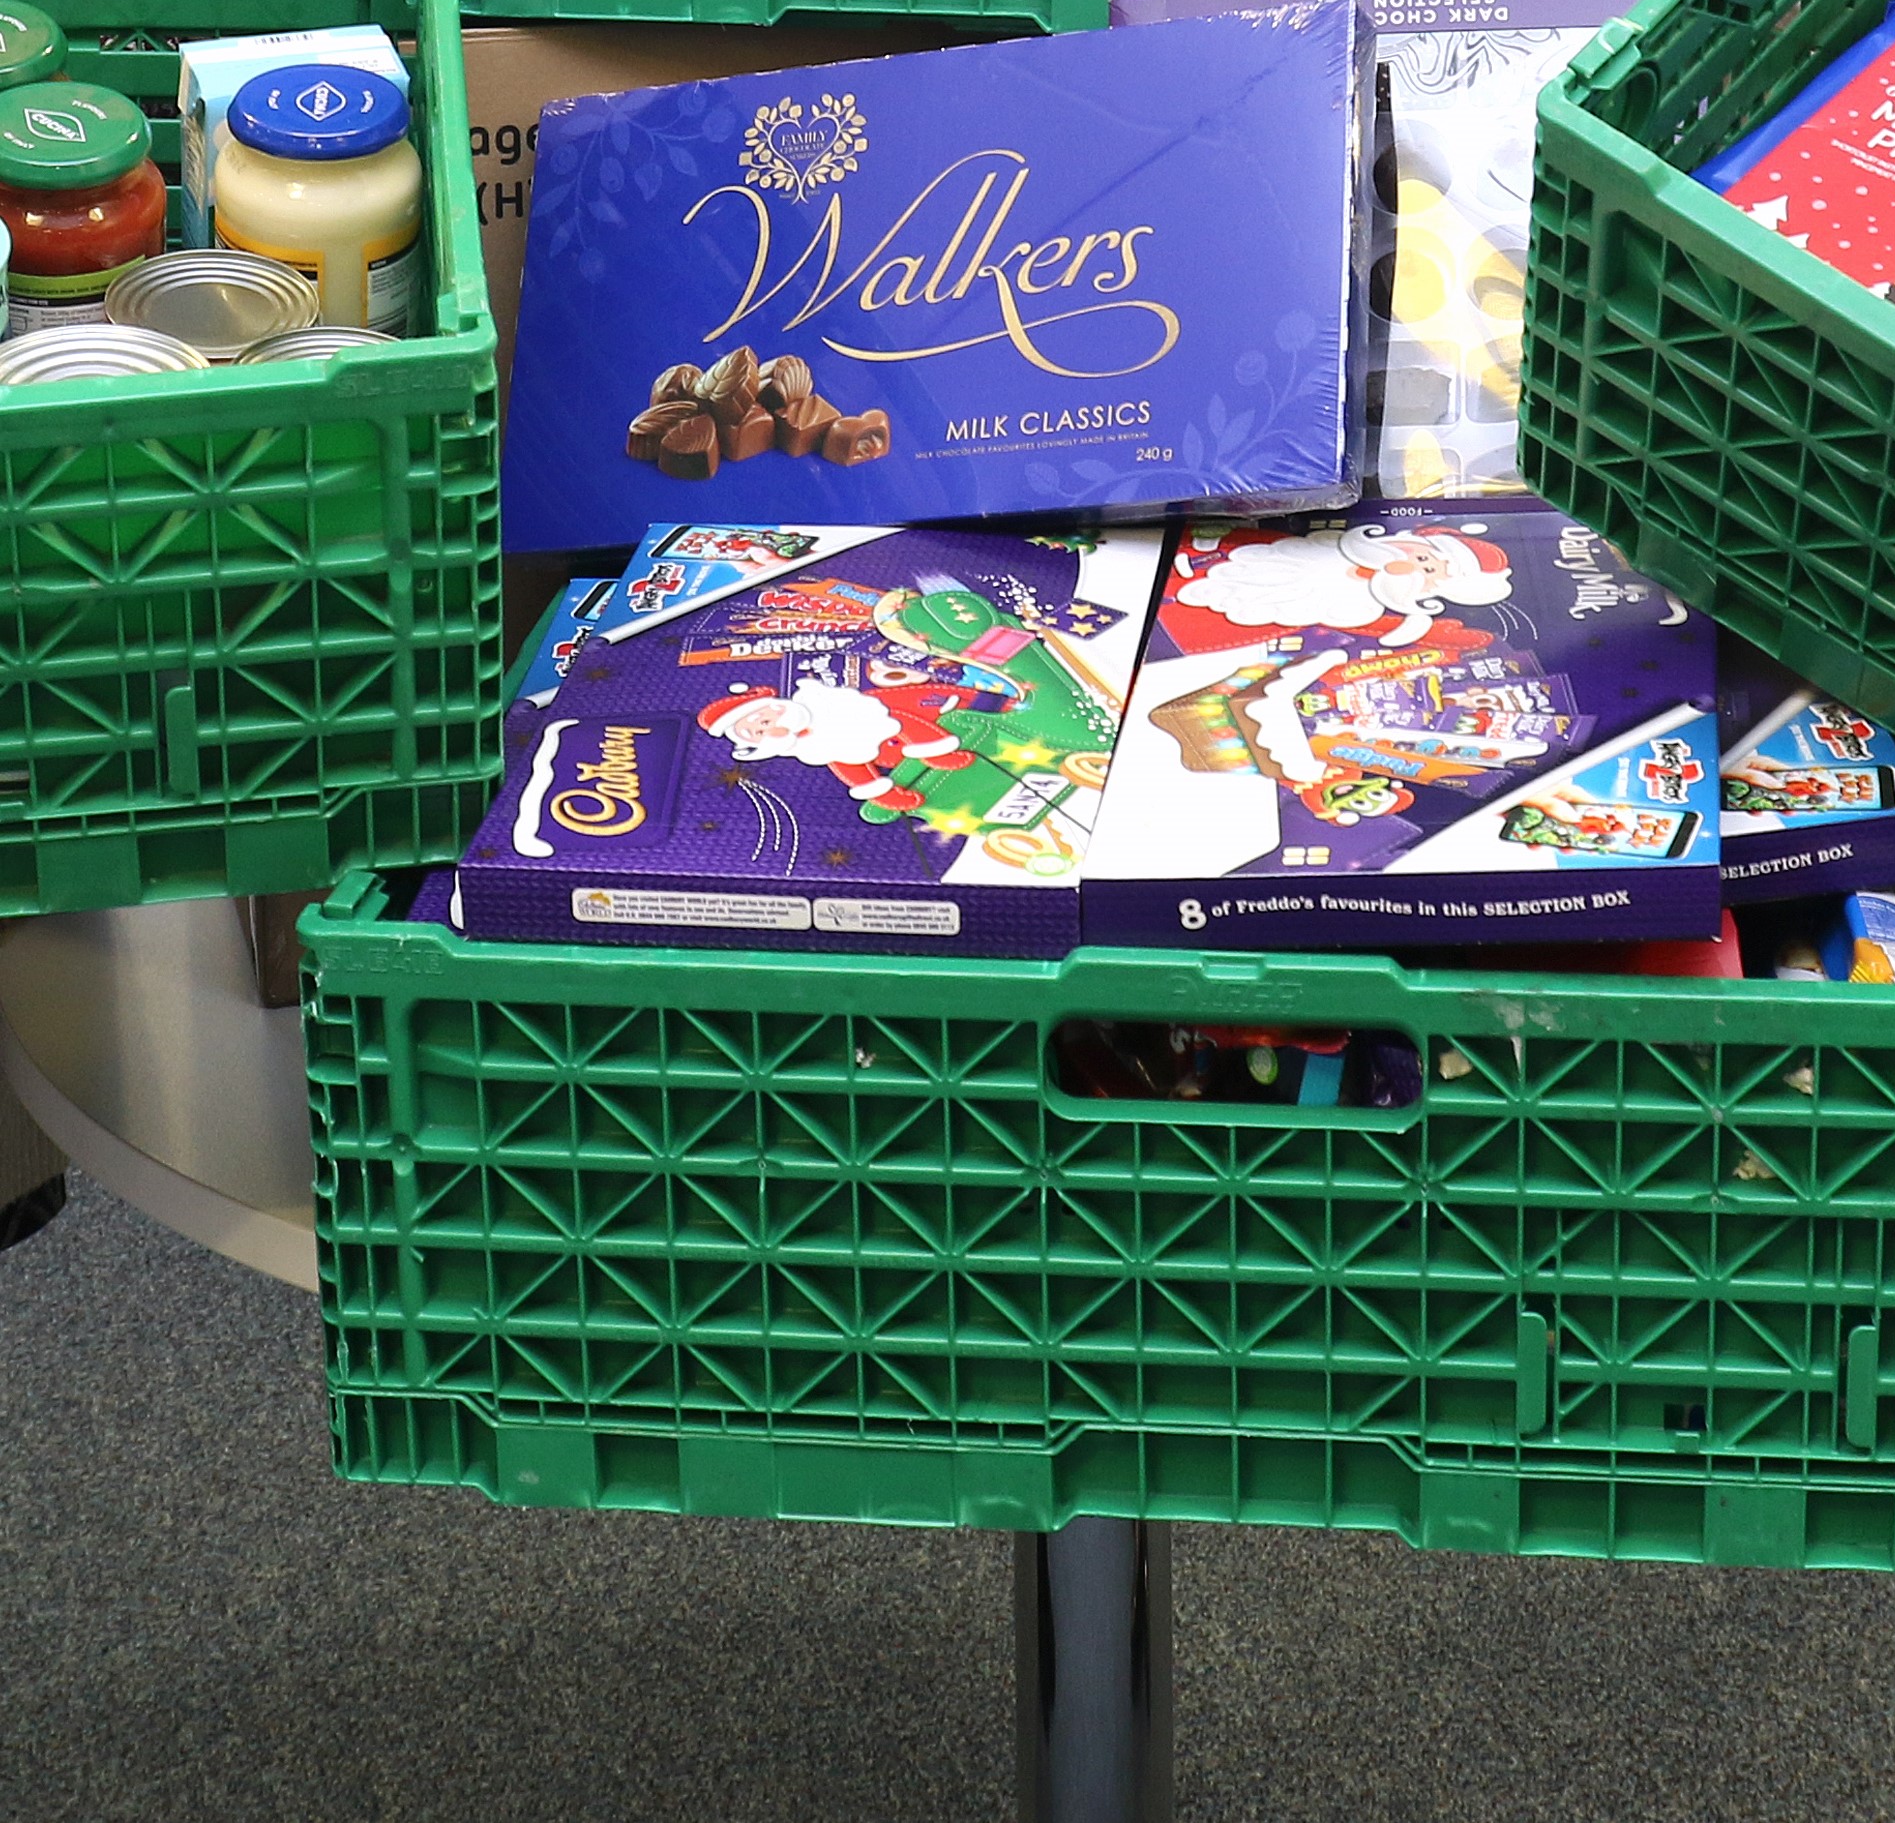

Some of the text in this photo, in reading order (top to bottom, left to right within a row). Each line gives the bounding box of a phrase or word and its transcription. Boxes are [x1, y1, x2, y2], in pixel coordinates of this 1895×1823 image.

[1375, 7, 1509, 26] DARK CHOC
[32, 113, 76, 140] CUCINA
[683, 148, 1181, 378] Walkers
[946, 401, 1151, 441] MILK CLASSICS
[1136, 447, 1160, 462] 240
[1553, 526, 1600, 573] Dairy
[1568, 573, 1622, 621] Milk
[730, 637, 854, 658] Decker
[550, 725, 651, 836] Cadbury
[998, 780, 1060, 819] SANTA
[1720, 843, 1853, 881] SELECTION BOX
[1179, 890, 1630, 930] 8 of Freddo's favourites in this SELECTION BOX
